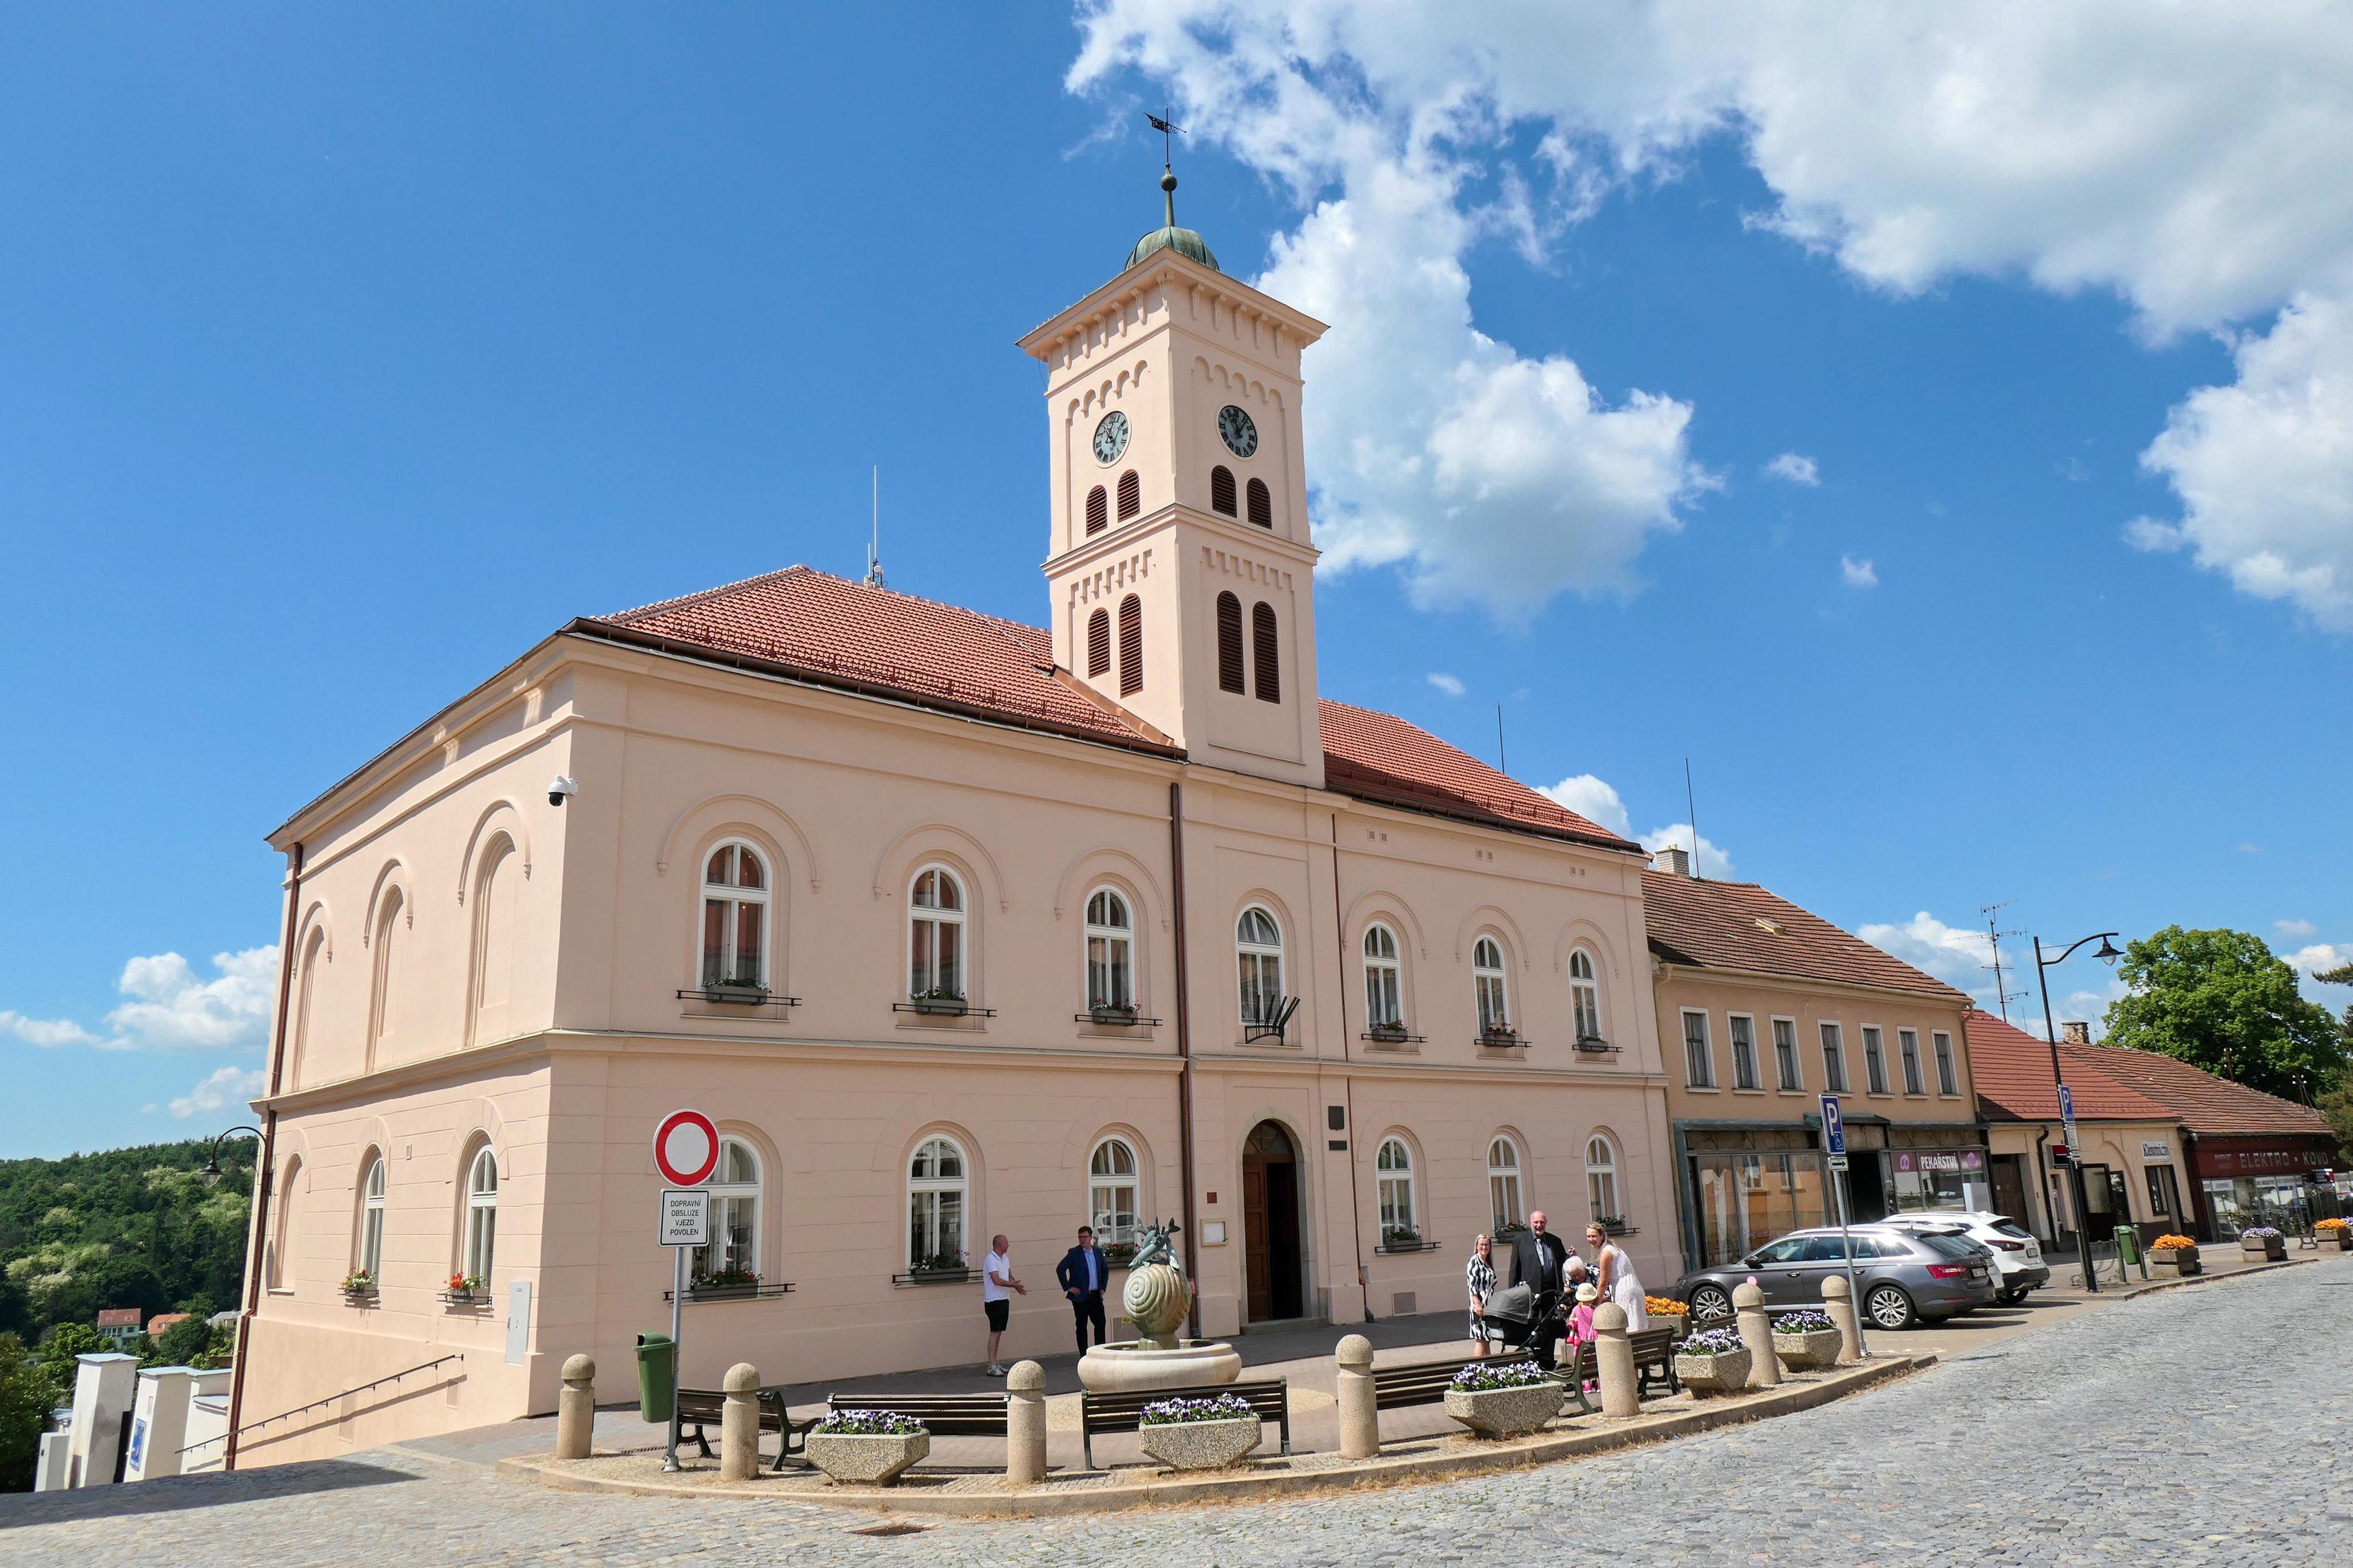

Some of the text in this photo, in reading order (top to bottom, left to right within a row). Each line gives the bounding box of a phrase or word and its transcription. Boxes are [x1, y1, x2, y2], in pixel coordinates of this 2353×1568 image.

[2063, 1090, 2069, 1111] P
[1826, 1103, 1838, 1136] P
[1921, 1153, 1957, 1169] PEKAŘSTVÍ
[2239, 1152, 2290, 1169] ELEKTRO
[2302, 1152, 2329, 1166] KOVO
[670, 1199, 701, 1207] DOPRAVNÍ
